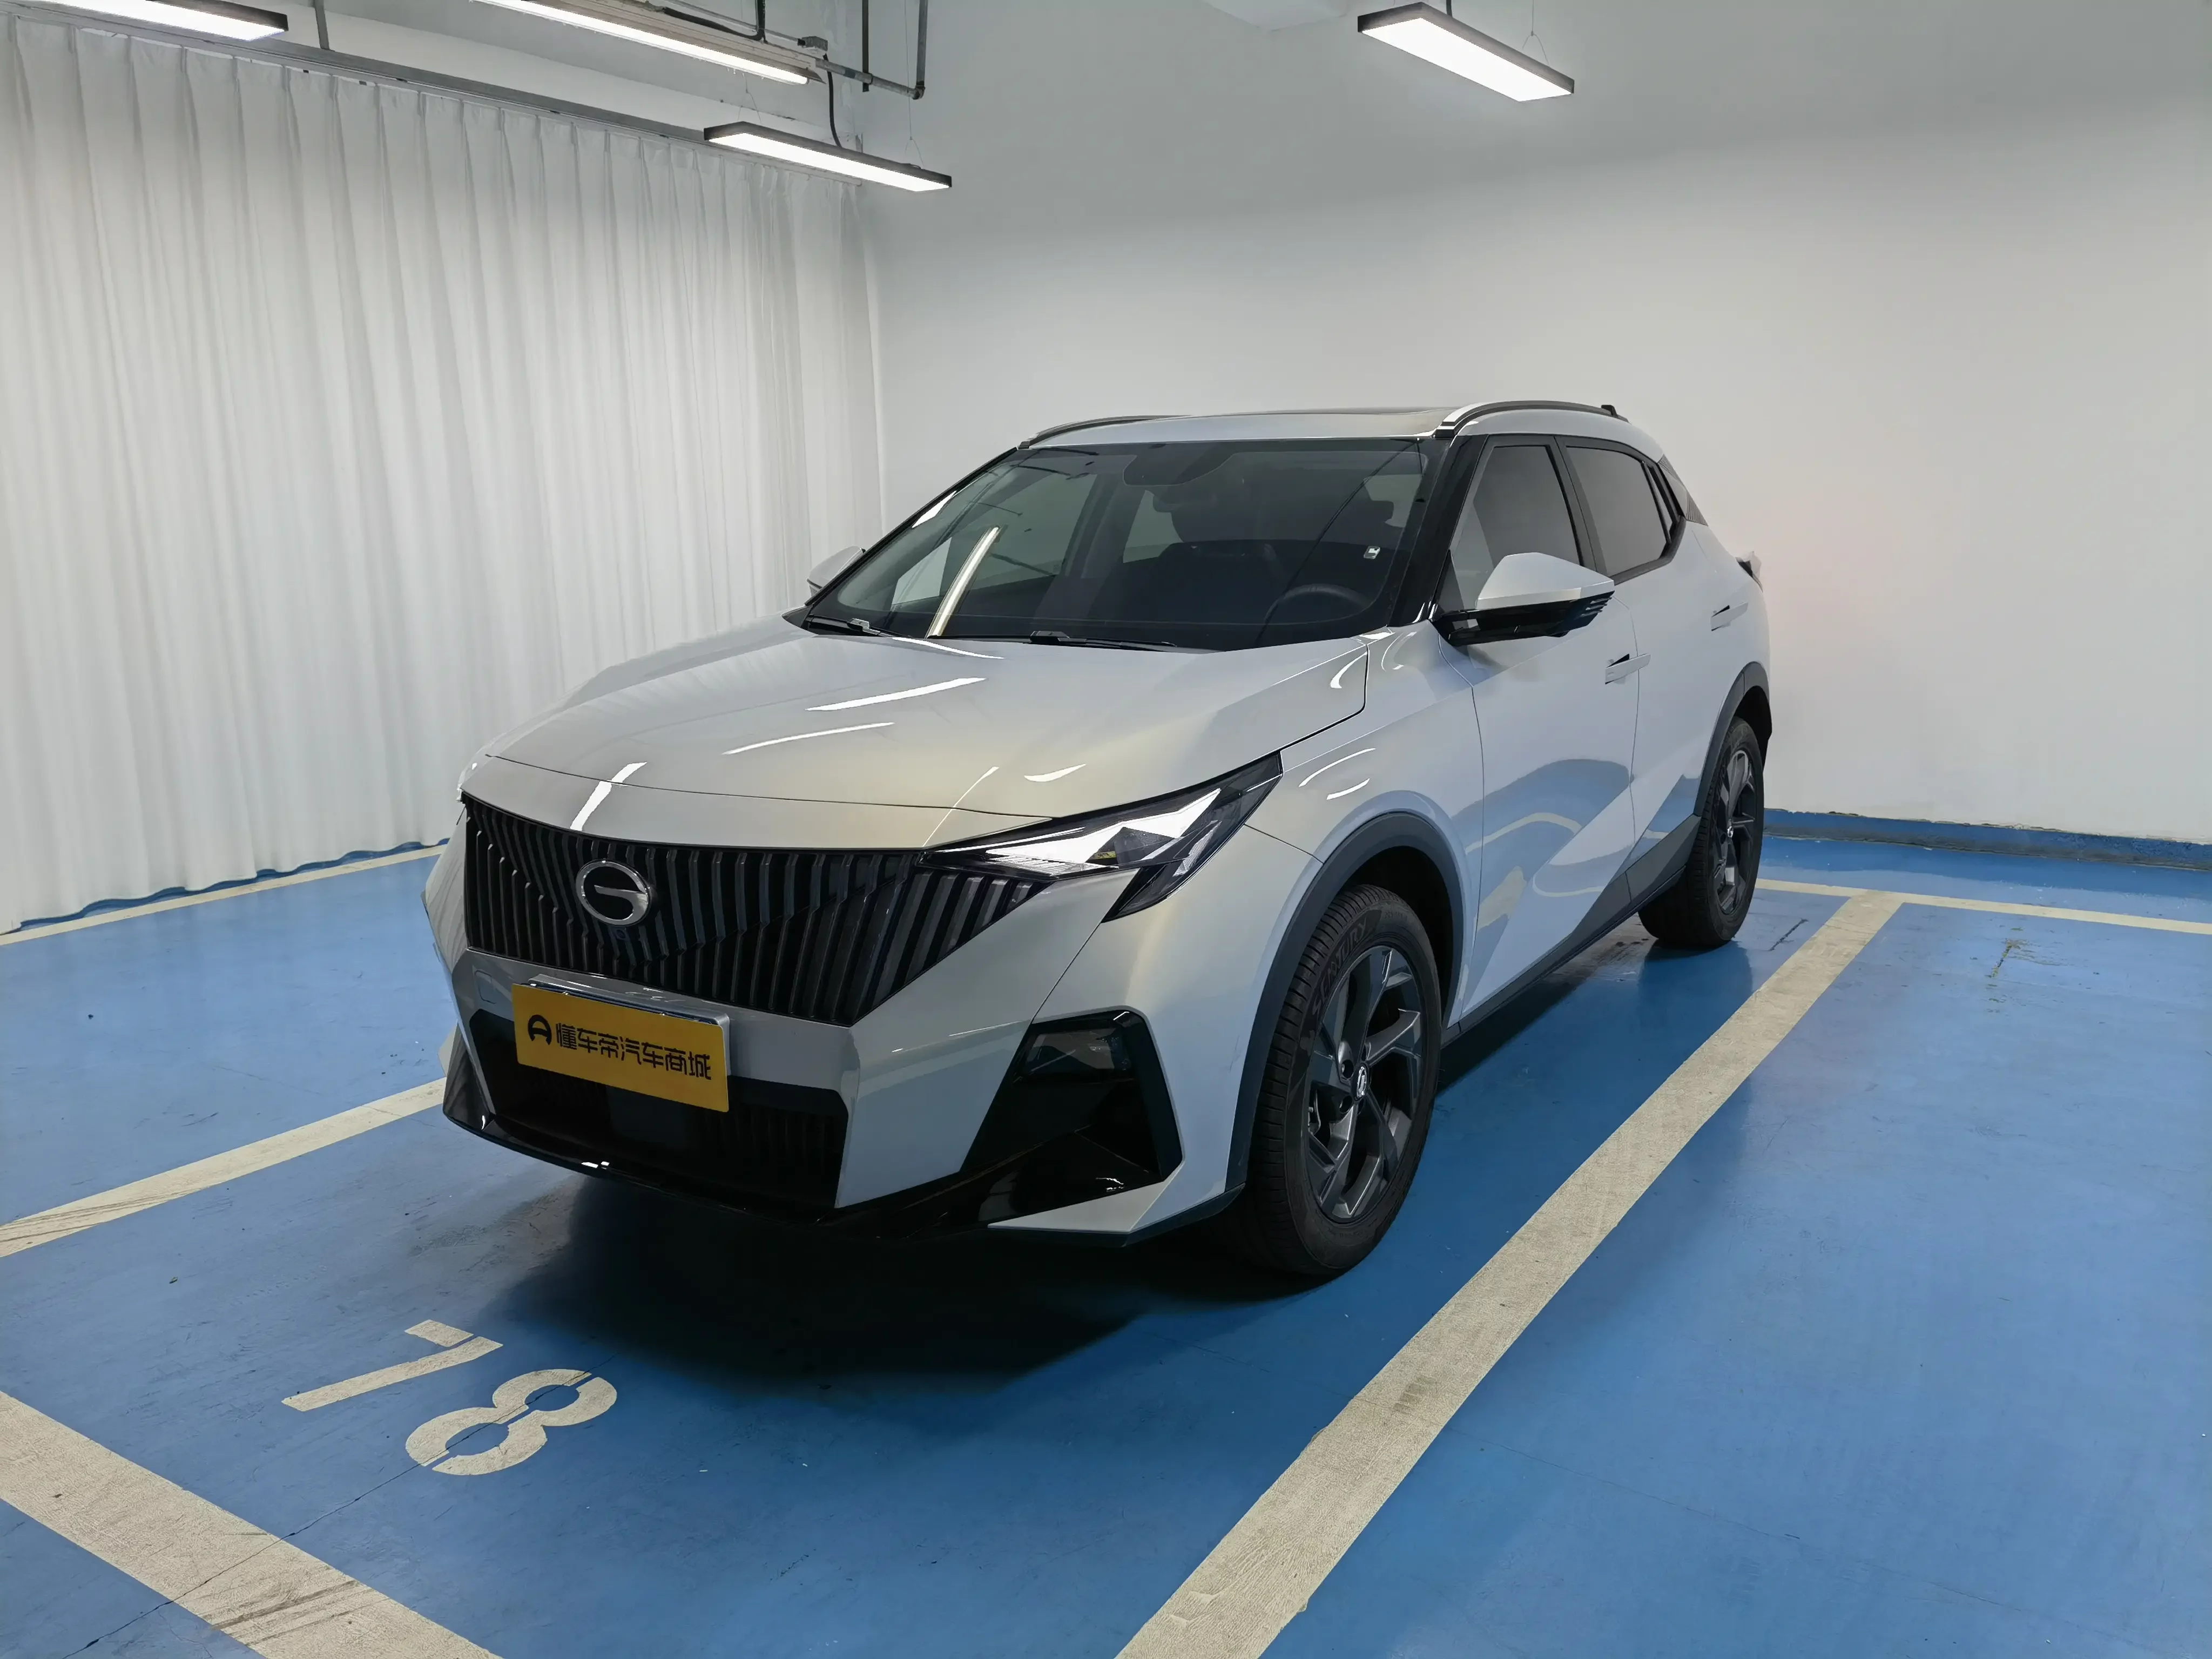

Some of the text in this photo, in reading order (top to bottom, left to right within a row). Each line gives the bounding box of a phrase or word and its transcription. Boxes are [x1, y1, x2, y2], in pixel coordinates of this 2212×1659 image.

[1312, 916, 1368, 1016] SENTURY
[555, 1022, 712, 1080] 懂车帝汽车商城
[281, 1319, 618, 1476] 78
